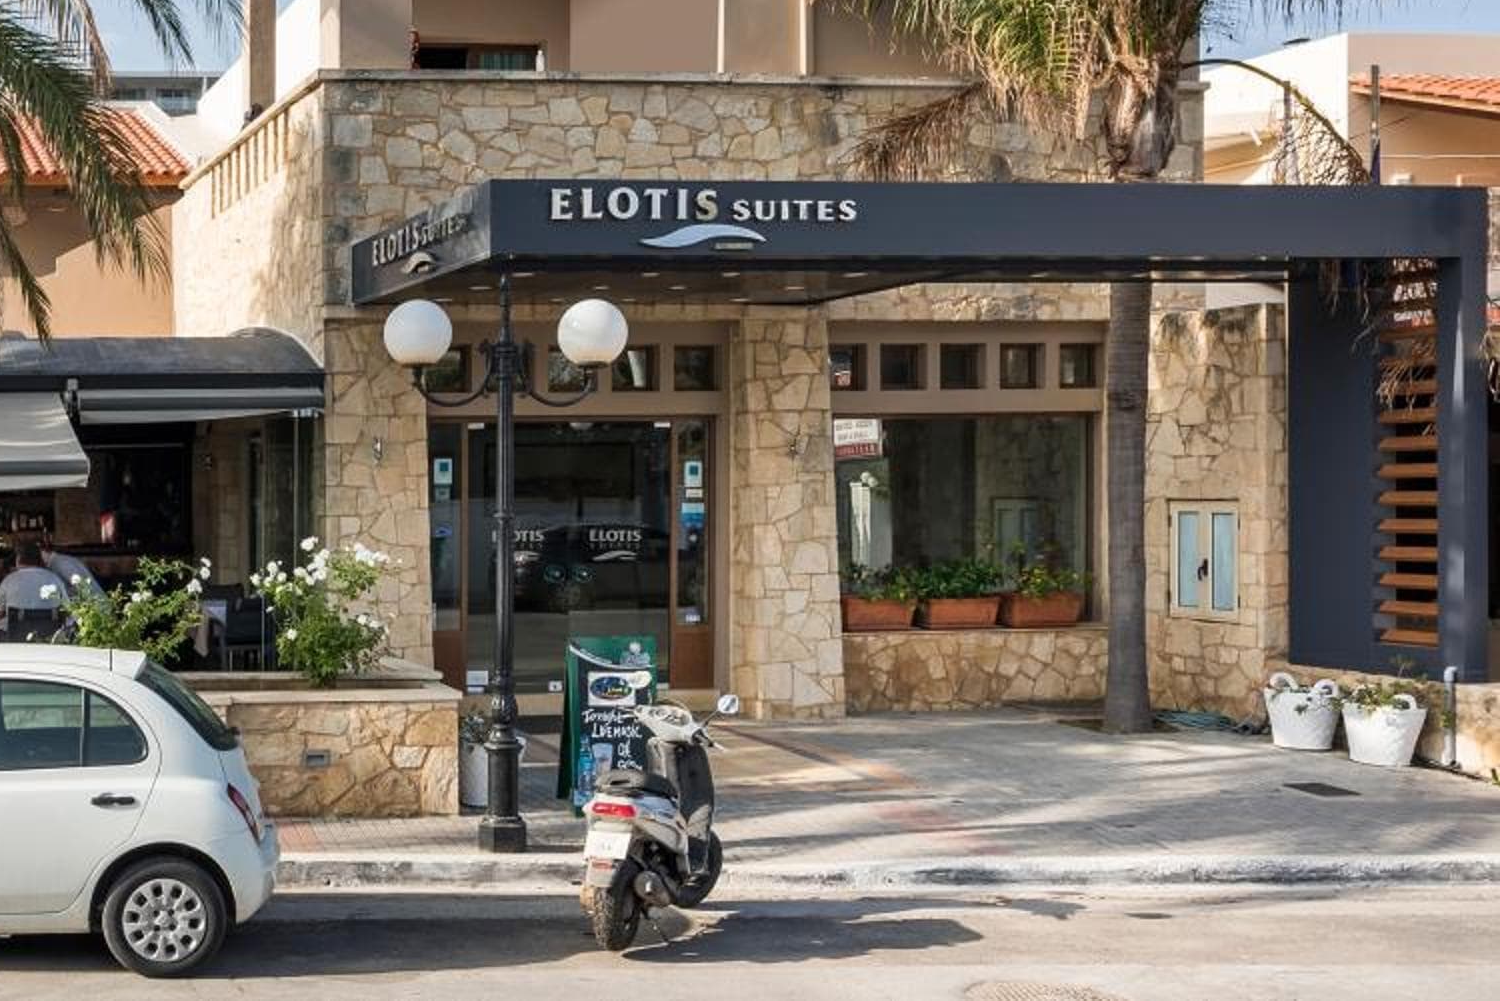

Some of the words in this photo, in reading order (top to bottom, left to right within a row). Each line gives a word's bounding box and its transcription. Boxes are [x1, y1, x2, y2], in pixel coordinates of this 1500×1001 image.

[550, 187, 719, 221] ELOTIS
[731, 199, 858, 221] SUITES
[372, 221, 419, 267] ELOTIS
